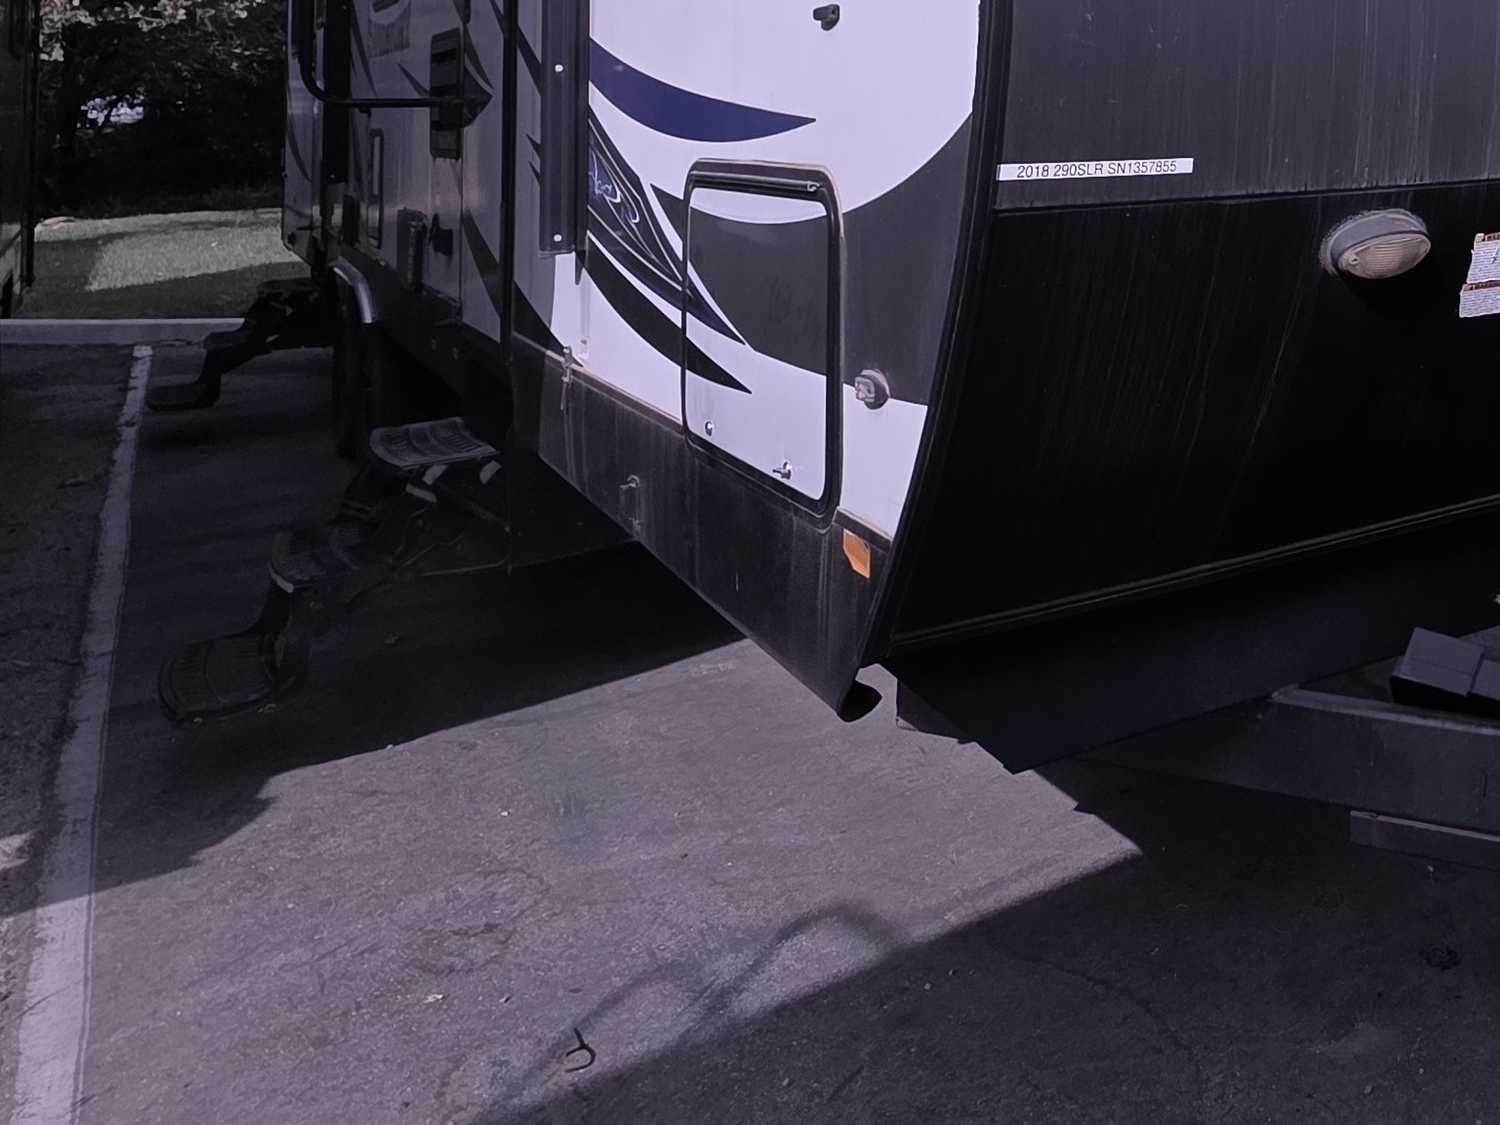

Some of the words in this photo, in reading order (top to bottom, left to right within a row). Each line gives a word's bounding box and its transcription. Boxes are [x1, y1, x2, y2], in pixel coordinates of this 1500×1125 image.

[1016, 164, 1050, 179] 2018
[1053, 162, 1104, 178] 290SLR
[1107, 160, 1178, 176] SN1357855
